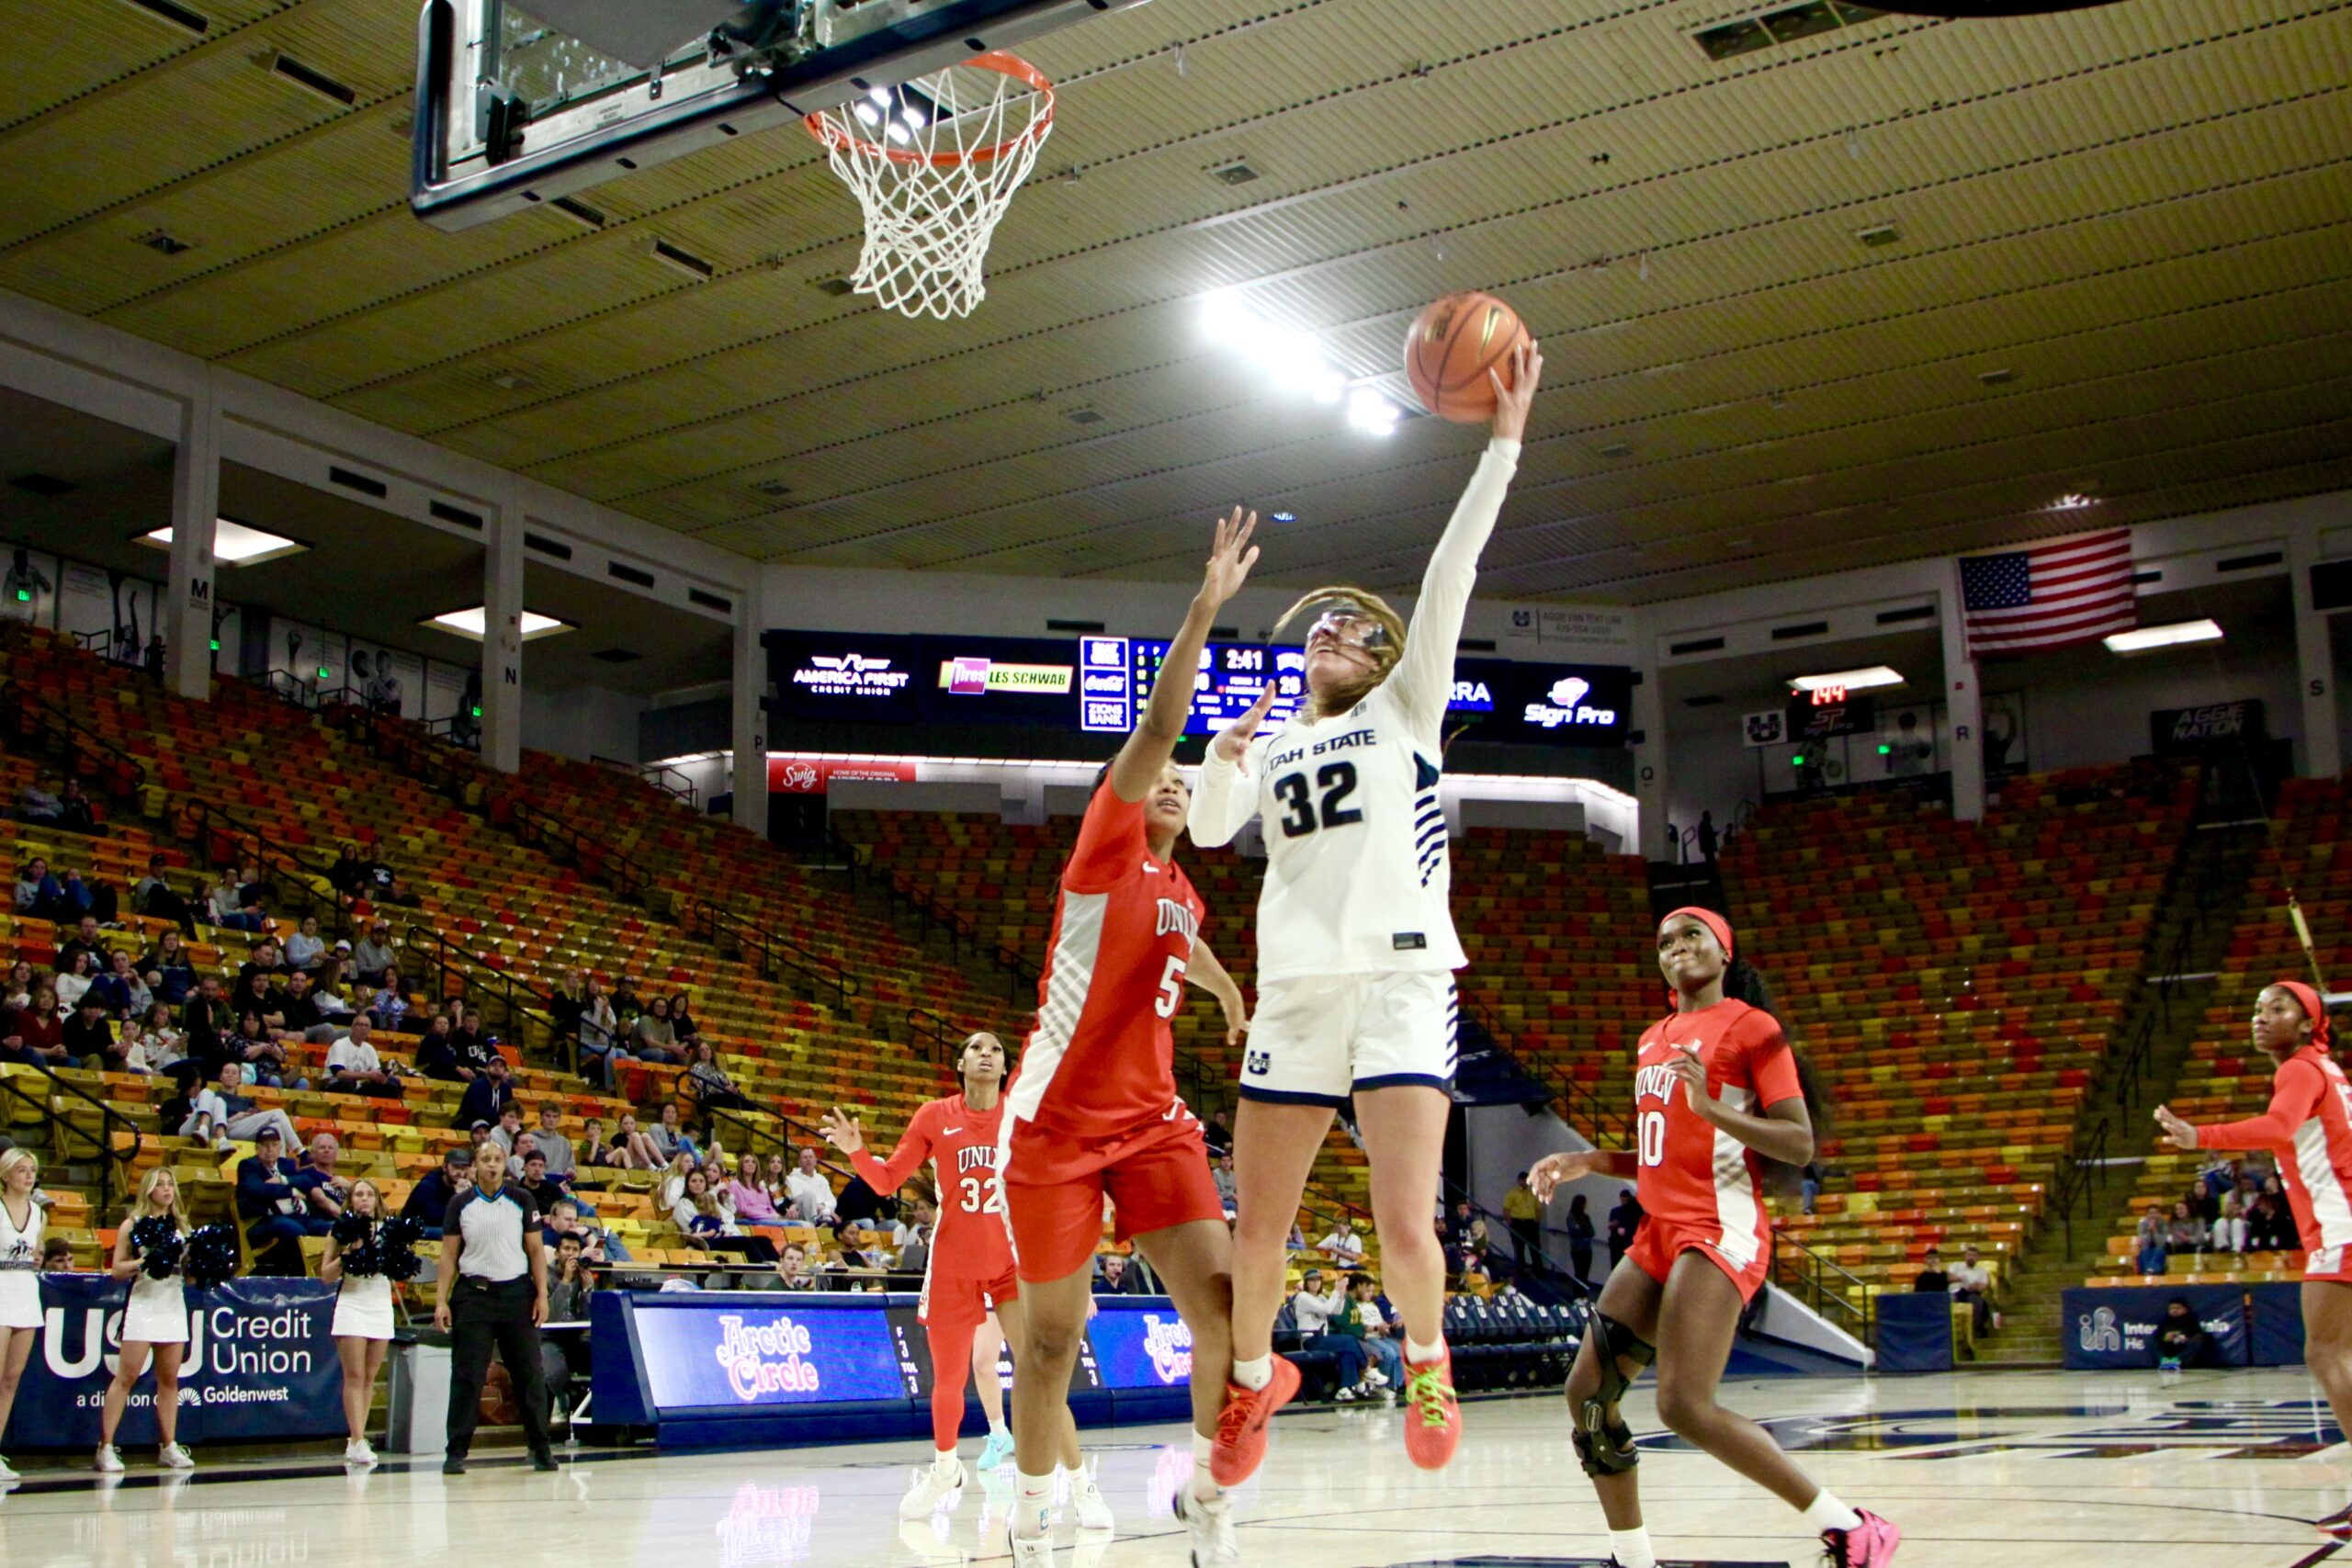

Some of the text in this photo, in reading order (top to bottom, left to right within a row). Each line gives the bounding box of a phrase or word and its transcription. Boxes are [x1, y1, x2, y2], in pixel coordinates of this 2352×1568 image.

[192, 578, 208, 600] M
[1227, 649, 1261, 670] 2:41
[506, 666, 516, 685] N
[793, 669, 909, 687] AMERICA FIRST
[989, 671, 1066, 685] LES SCHWAB
[810, 684, 891, 696] CREDIT UNION
[2310, 680, 2324, 696] S
[1089, 704, 1123, 715] ZIONS
[1090, 714, 1123, 725] BANK
[1523, 704, 1614, 728] Sign Pro
[2177, 703, 2245, 724] AGGIE
[1956, 726, 1969, 741] R
[2172, 718, 2244, 741] NATION
[754, 735, 763, 750] P
[1268, 729, 1376, 773] TAH STATE
[783, 766, 817, 789] Swig
[832, 769, 850, 777] HOME
[1273, 761, 1363, 838] 32
[1155, 954, 1186, 1019] 5
[1637, 1111, 1665, 1167] 10
[957, 1146, 998, 1173] UNL
[960, 1177, 1001, 1213] 32
[211, 1306, 311, 1338] Credit
[716, 1314, 812, 1367] Arctic
[213, 1343, 311, 1374] Union
[728, 1353, 820, 1400] Circle
[77, 1394, 85, 1406] a
[90, 1391, 150, 1407] diion
[203, 1386, 288, 1403] Goldenwest
